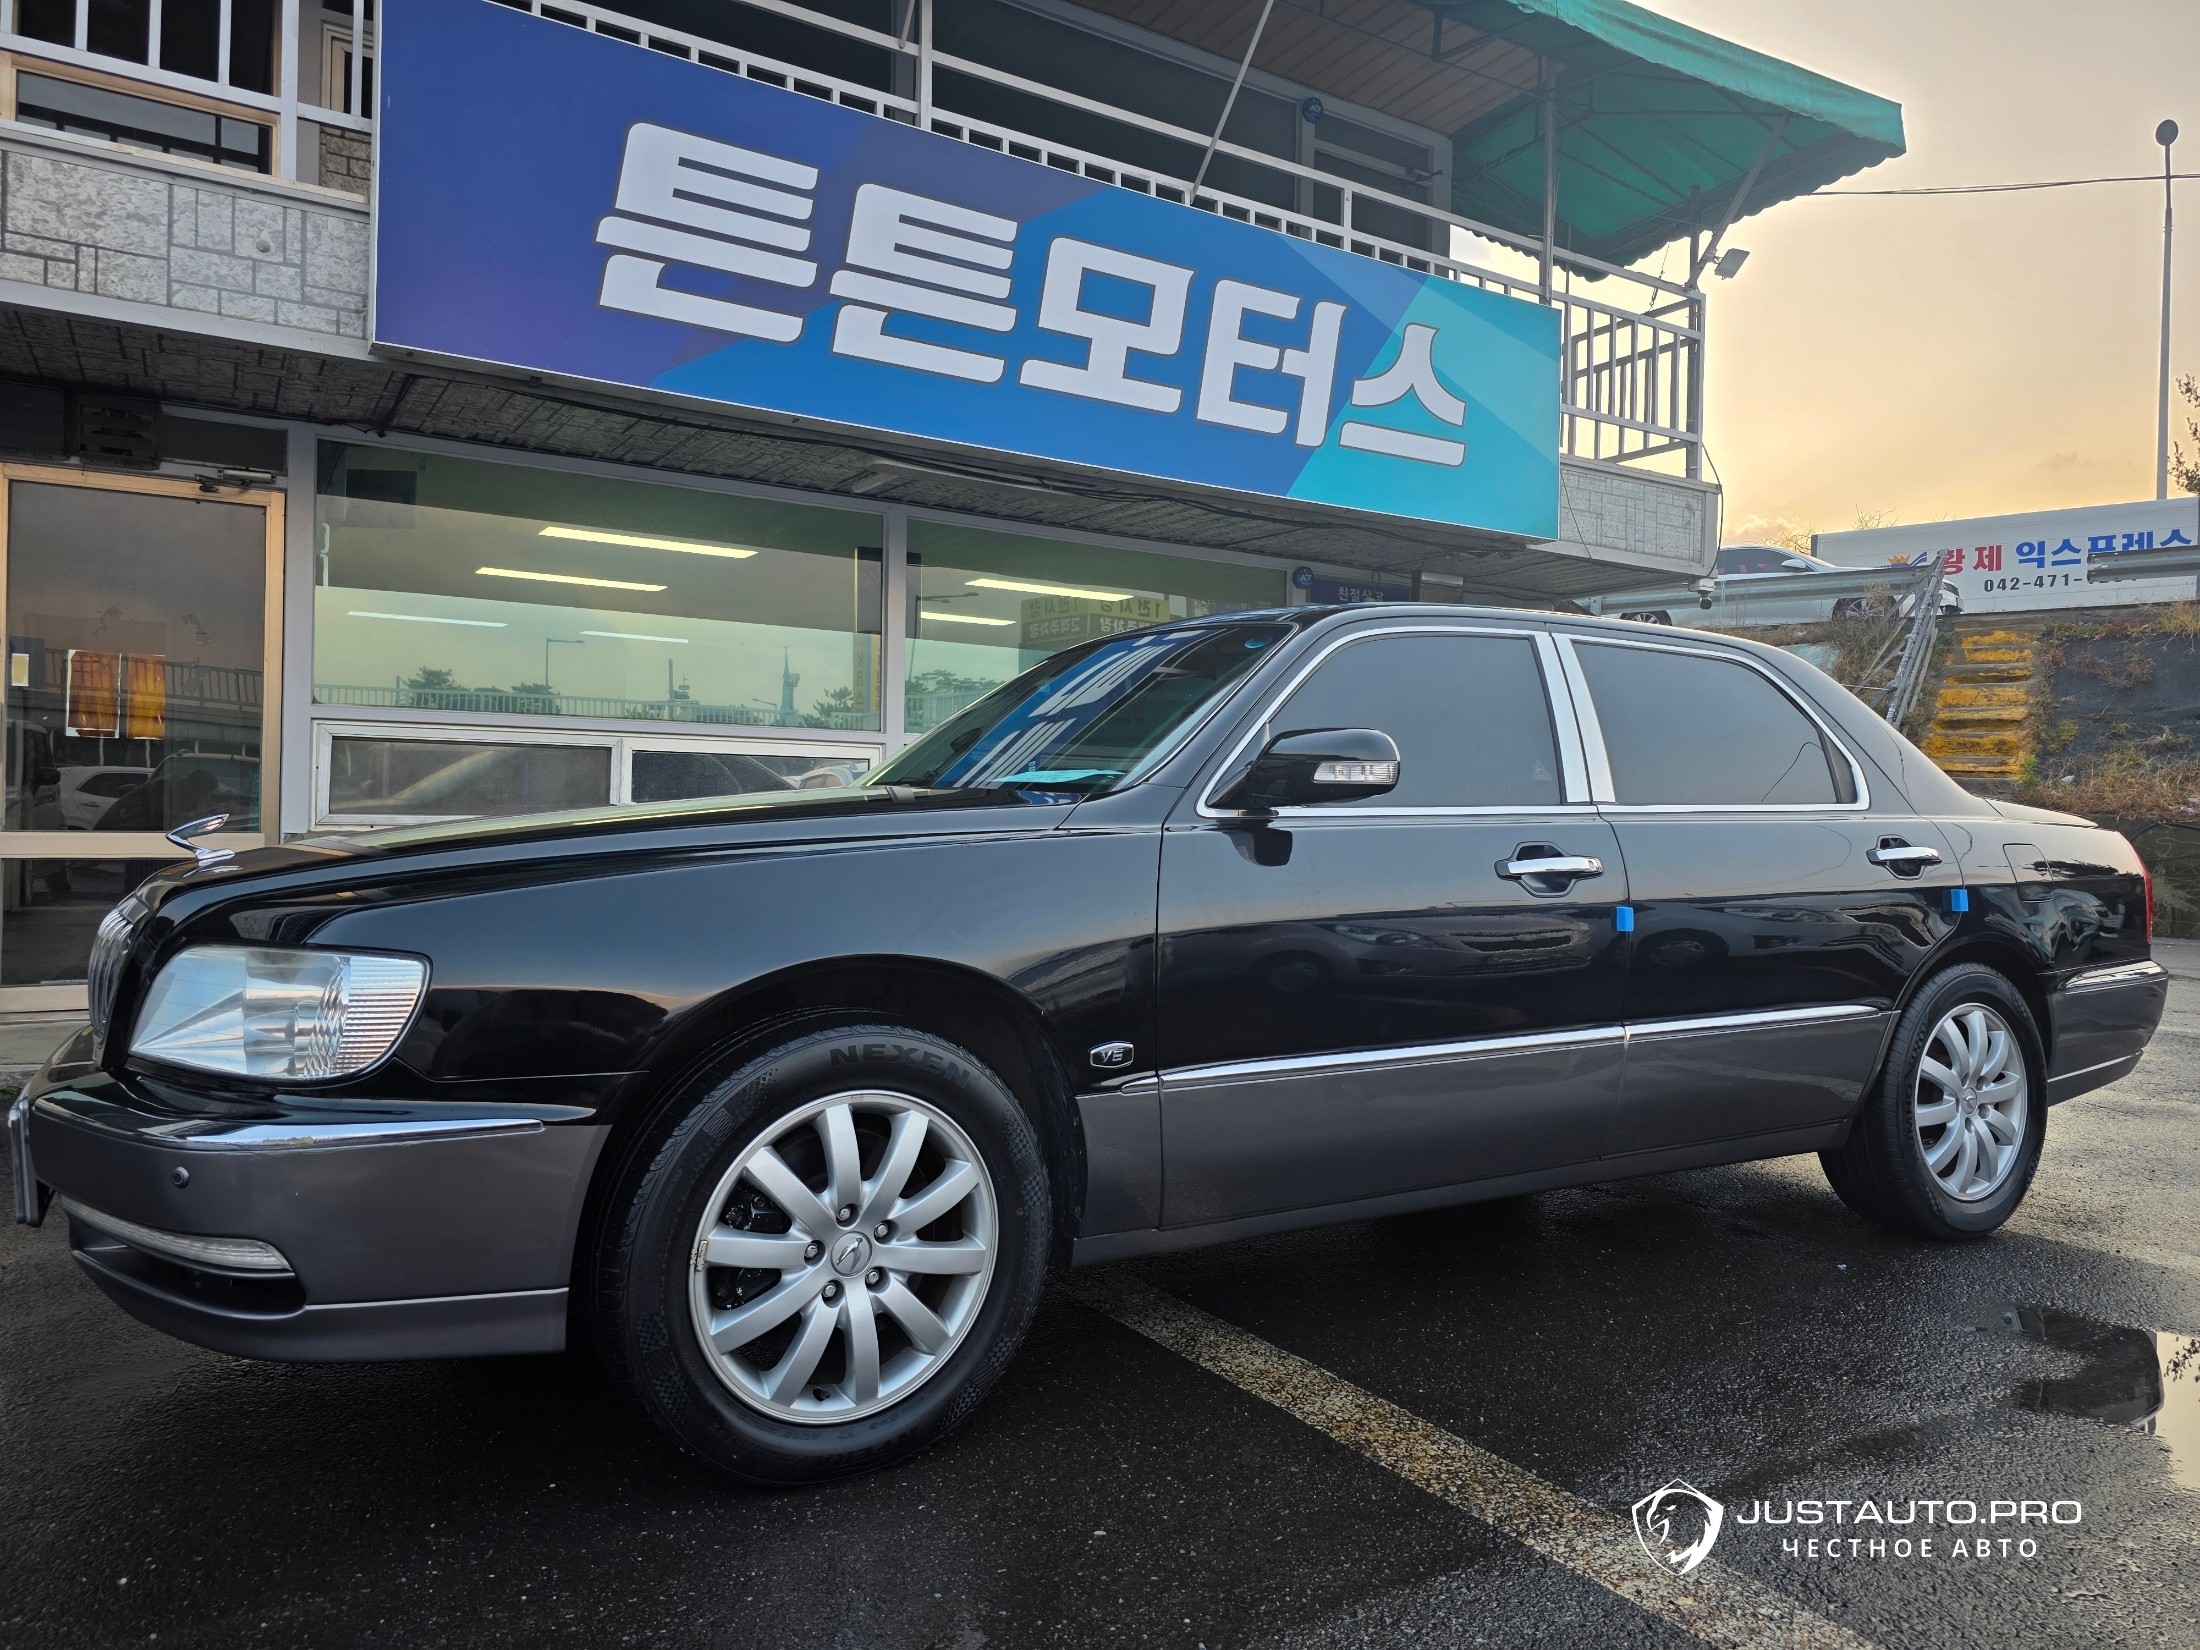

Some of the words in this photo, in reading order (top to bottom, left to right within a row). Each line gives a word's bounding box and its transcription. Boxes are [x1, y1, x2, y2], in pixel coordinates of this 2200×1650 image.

[595, 121, 1468, 468] 튼튼모터스
[2016, 529, 2192, 569] 익스프레스
[1984, 573, 2137, 592] 042-471-
[829, 1043, 971, 1088] NEXEN
[1101, 1048, 1125, 1063] V6
